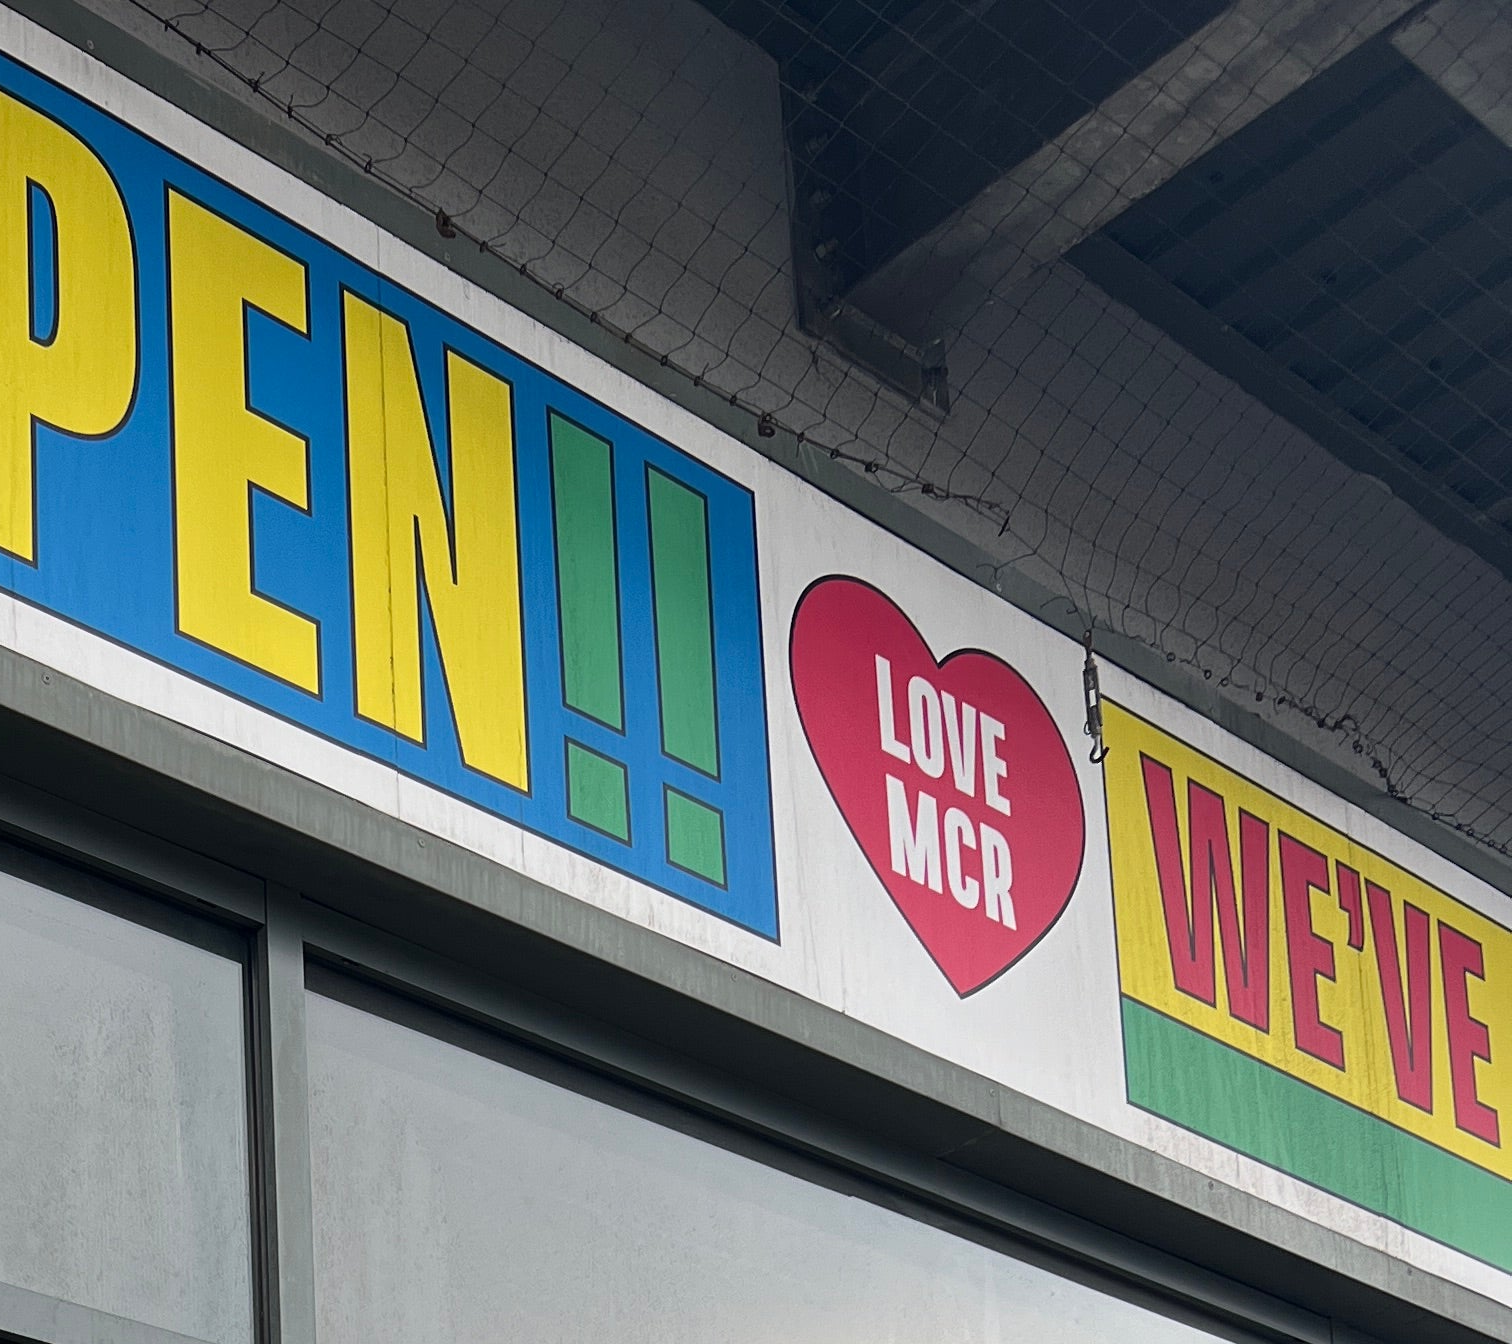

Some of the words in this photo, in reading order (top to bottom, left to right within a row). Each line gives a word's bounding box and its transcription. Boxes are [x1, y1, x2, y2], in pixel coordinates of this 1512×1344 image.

[875, 653, 1011, 817] LOVE
[886, 774, 1019, 932] MCR
[1139, 751, 1501, 1148] WE'VE
